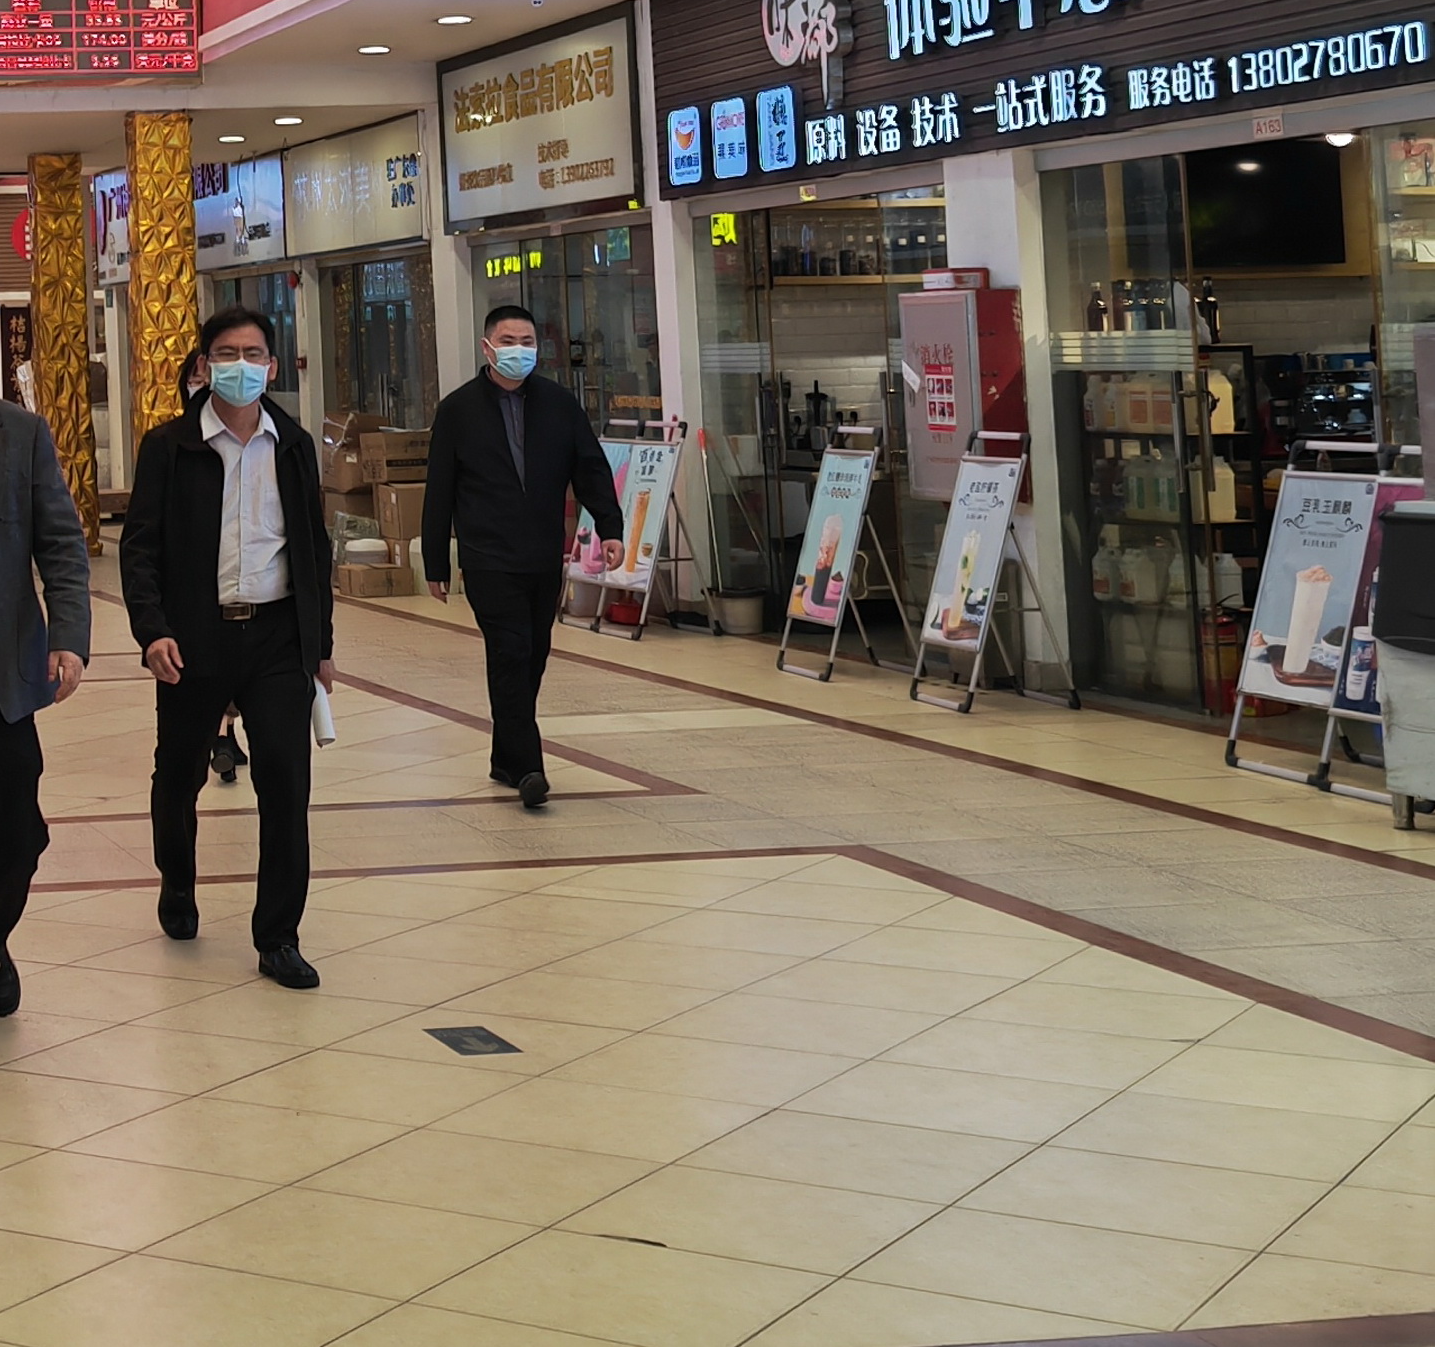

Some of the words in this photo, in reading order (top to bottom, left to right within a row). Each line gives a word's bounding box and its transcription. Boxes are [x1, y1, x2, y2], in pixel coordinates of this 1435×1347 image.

[1128, 56, 1216, 110] 服务电话
[1227, 20, 1426, 94] 13802780670
[806, 114, 847, 166] 原料
[856, 104, 901, 157] 设备
[910, 91, 961, 148] 技术
[972, 64, 1107, 133] 一站式服务
[1255, 117, 1282, 134] A163
